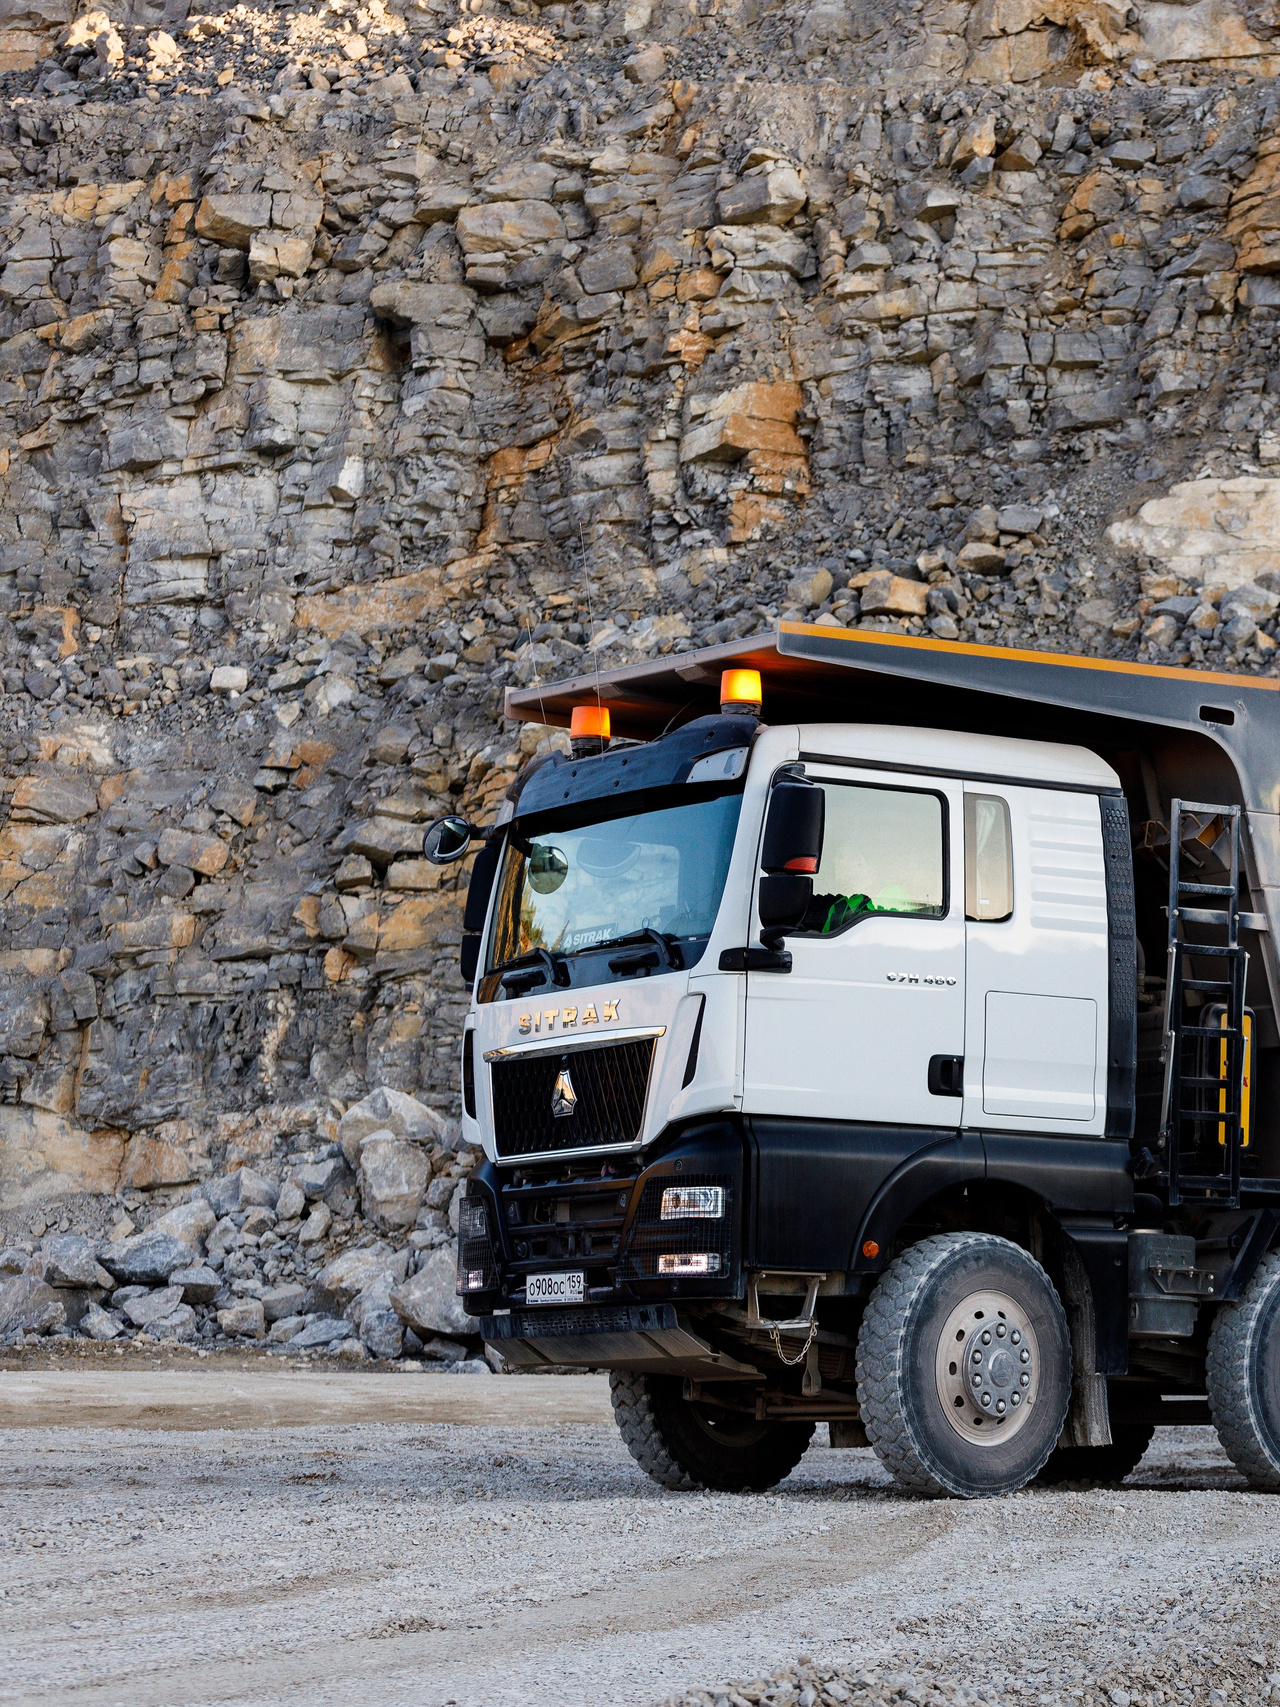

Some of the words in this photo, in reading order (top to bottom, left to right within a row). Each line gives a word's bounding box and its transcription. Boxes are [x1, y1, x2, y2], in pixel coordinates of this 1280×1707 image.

[575, 928, 611, 945] SITRAK
[886, 972, 919, 983] C7H
[923, 975, 957, 986] 480
[519, 999, 621, 1035] SITRAK
[567, 1275, 581, 1289] 159
